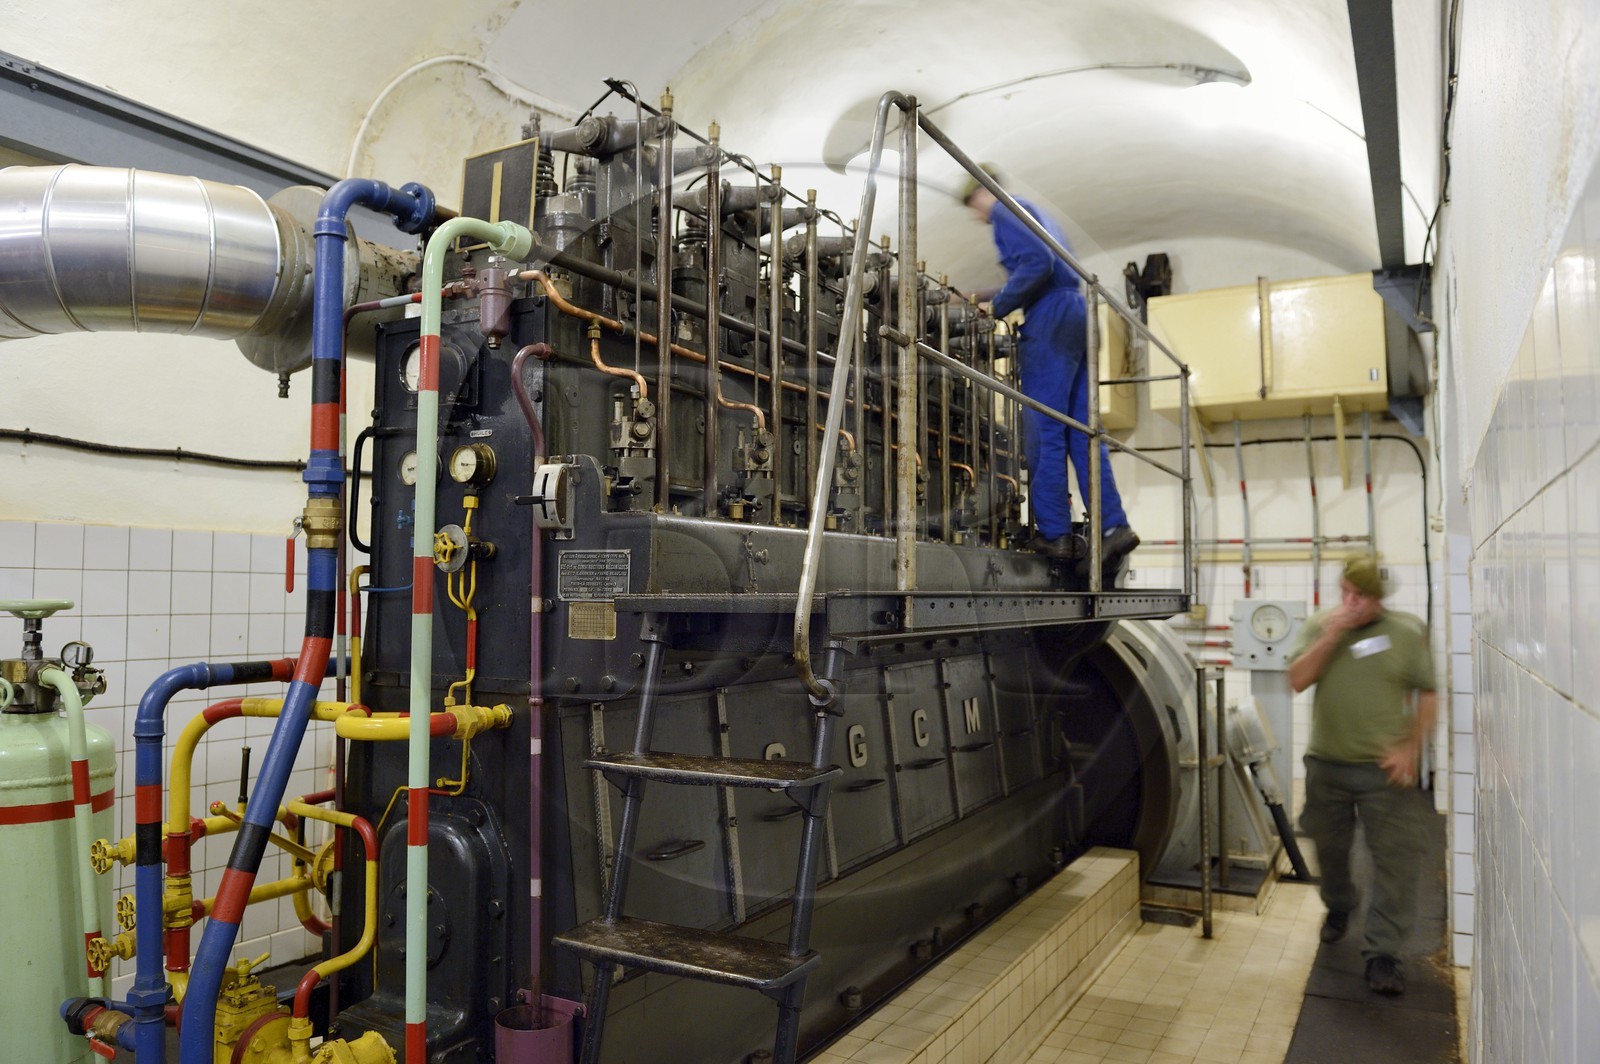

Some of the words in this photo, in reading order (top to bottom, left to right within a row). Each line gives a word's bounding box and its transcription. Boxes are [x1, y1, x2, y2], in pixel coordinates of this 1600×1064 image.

[849, 724, 868, 768] G
[913, 708, 930, 747] C
[963, 697, 981, 734] M
